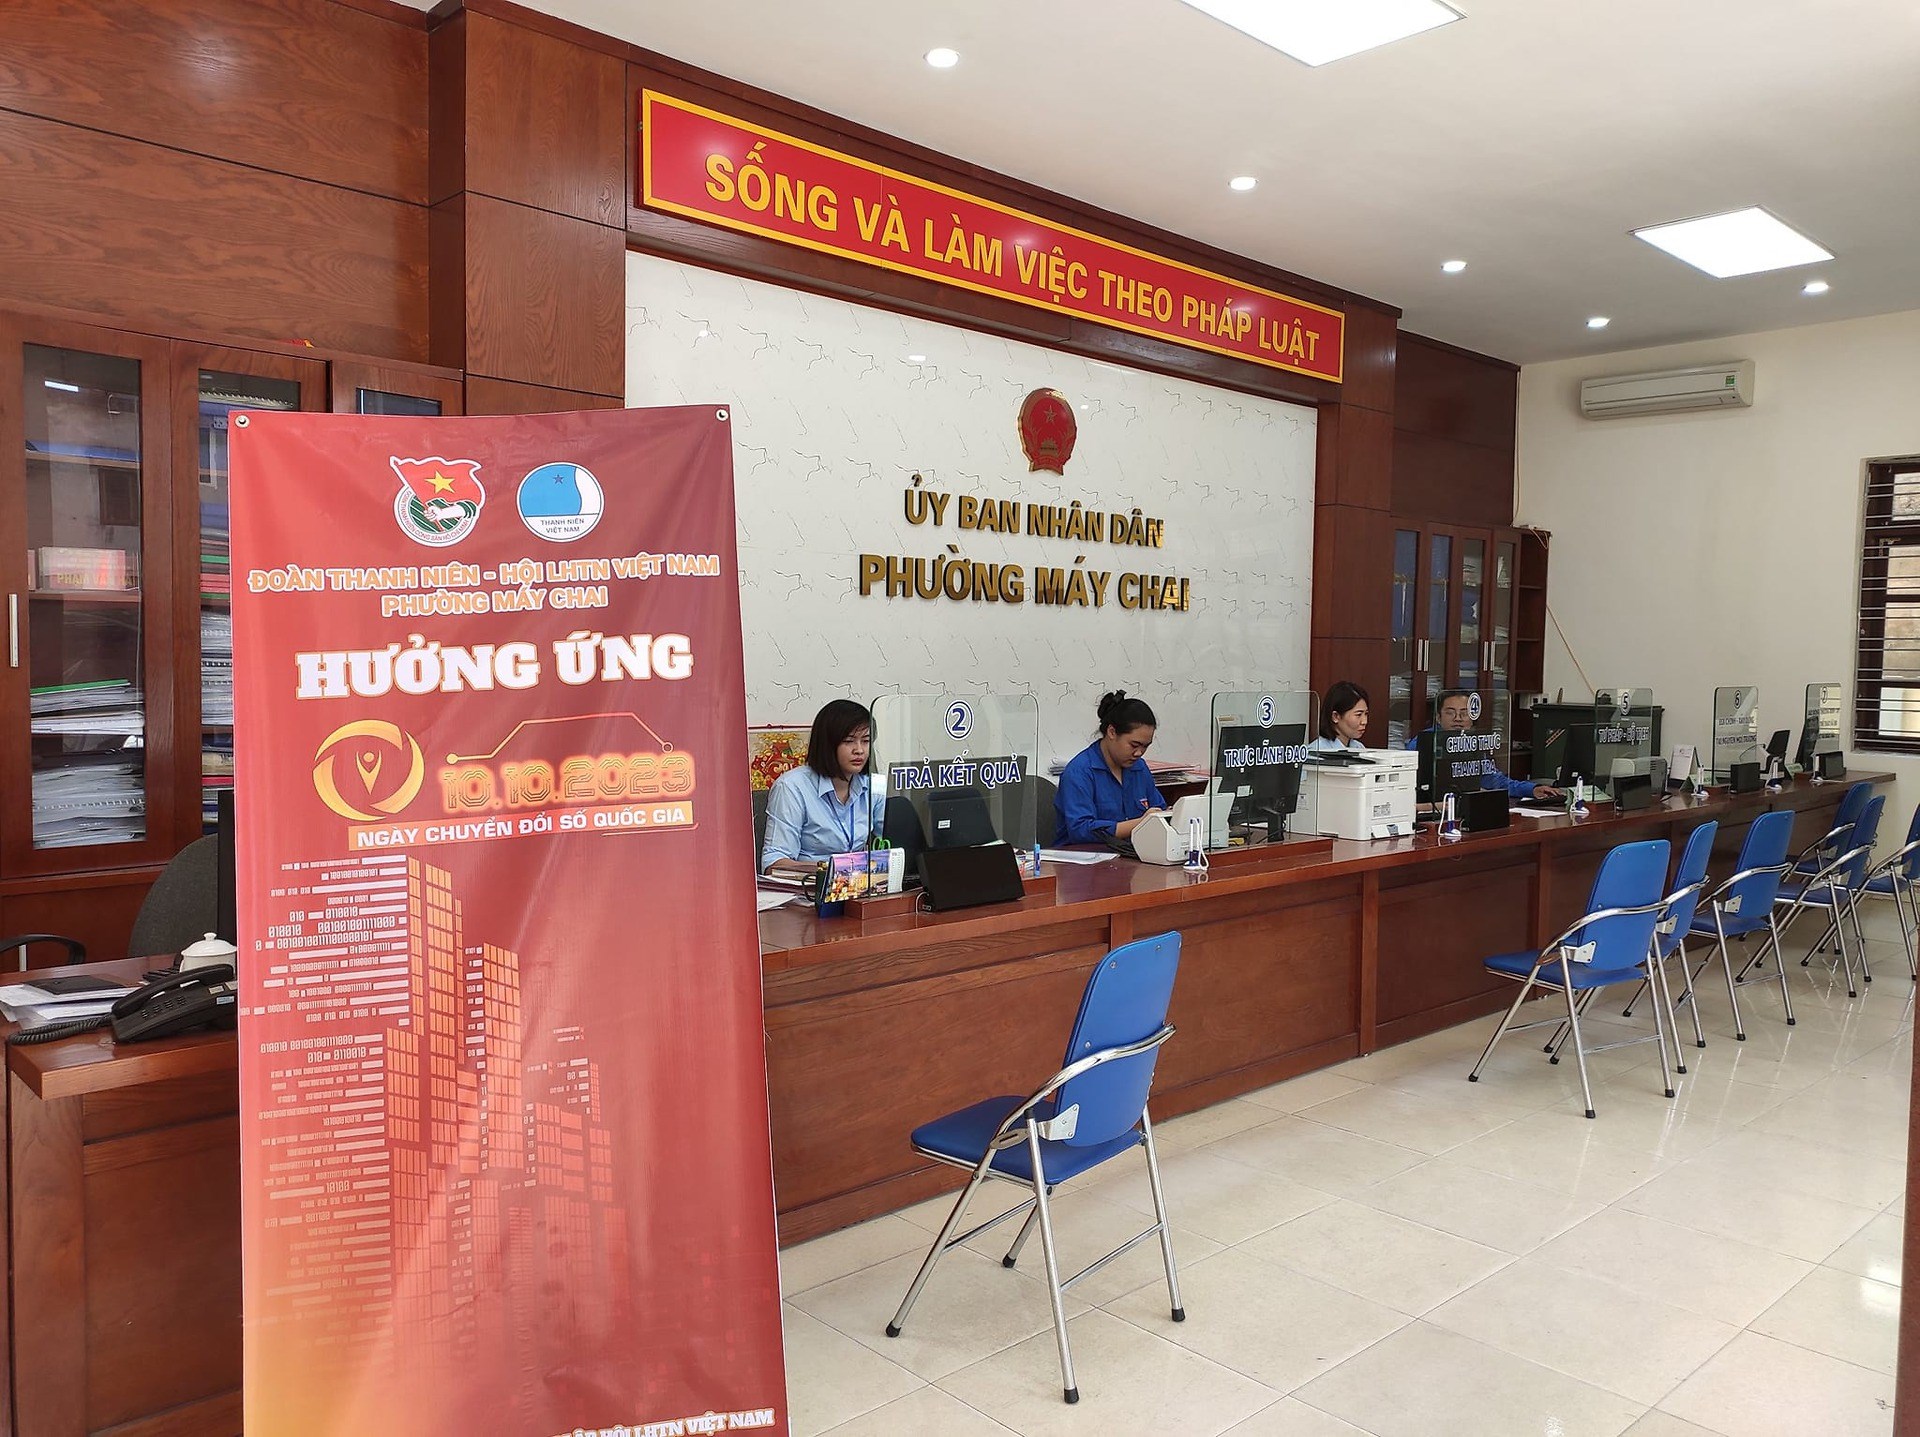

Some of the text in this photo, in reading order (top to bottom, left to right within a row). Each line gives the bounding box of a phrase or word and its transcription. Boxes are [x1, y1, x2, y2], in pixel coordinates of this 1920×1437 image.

[705, 142, 1321, 365] SỐNG VÀ LÀM VIỆC THEO PHÁP LUẬT
[904, 474, 1165, 548] ỦY BAN NHÂN DÂN
[546, 525, 562, 534] VIỆT
[249, 564, 325, 592] ĐOÀN
[326, 566, 420, 590] THANH
[422, 562, 481, 588] NIÊN
[500, 558, 543, 590] HỘI
[546, 560, 608, 583] LHTN
[613, 552, 665, 580] VIỆT
[666, 555, 720, 577] NAM
[859, 544, 1191, 611] PHƯỜNG MÁY CHAI
[381, 586, 609, 617] PHƯỜNG MÁY CHAI
[295, 630, 695, 699] HƯỞNG ỨNG
[951, 707, 966, 732] 2
[1261, 702, 1272, 721] 3
[1224, 739, 1308, 773] TRỰC LÃNH ĐẠO
[1446, 730, 1501, 755] CHỨNG THỰC
[441, 752, 695, 813] 10.10.2023
[892, 750, 1020, 790] TRẢ KẾT QUẢ
[1451, 759, 1497, 777] THANH TRA
[357, 807, 686, 848] NGÀY CHUYỂN ĐỔI SỐ QUỐC GIA
[268, 924, 302, 938] 010010
[686, 1410, 727, 1436] VIỆT
[729, 1407, 775, 1428] NAM
